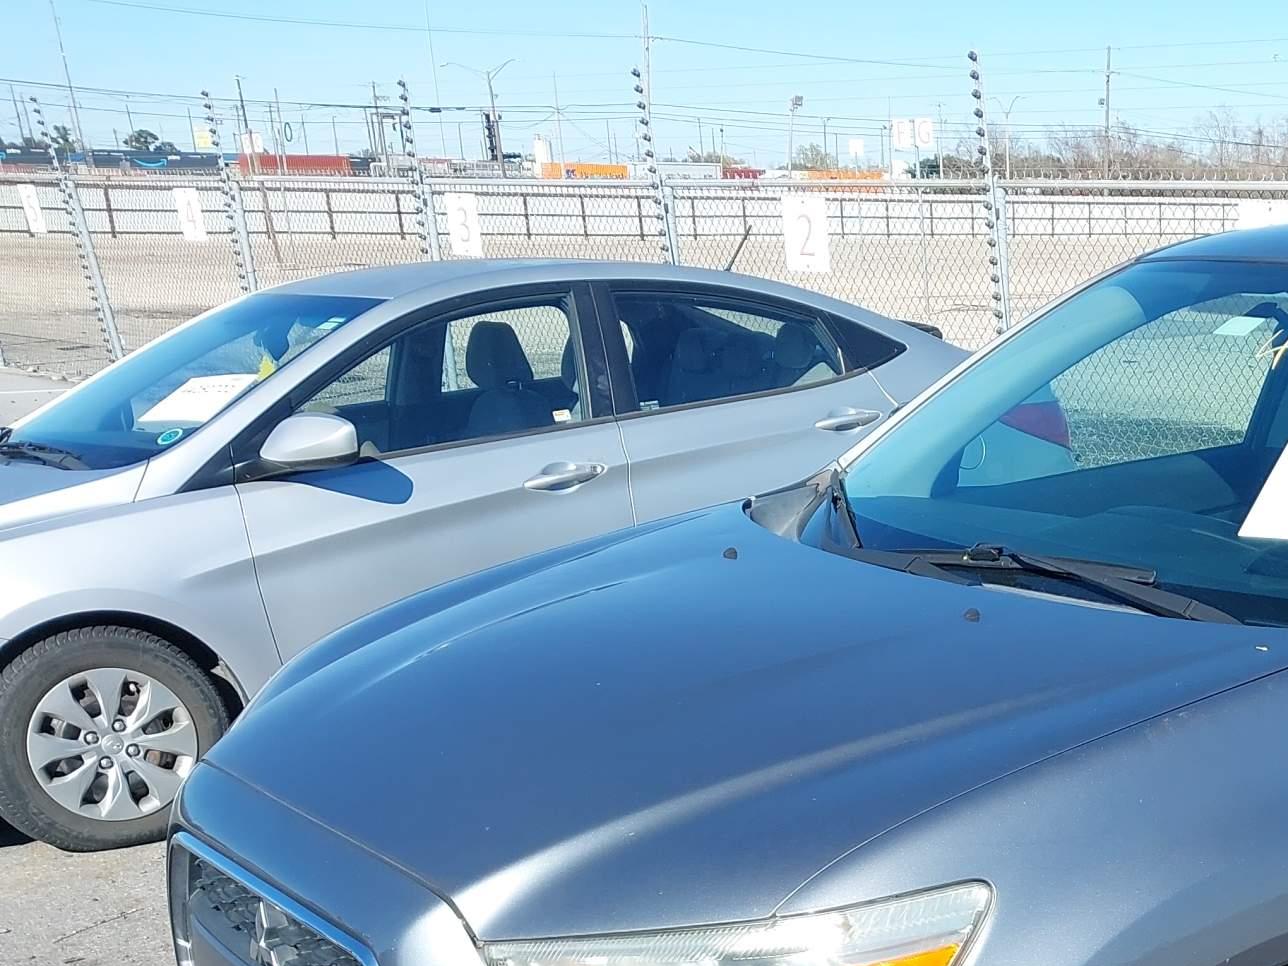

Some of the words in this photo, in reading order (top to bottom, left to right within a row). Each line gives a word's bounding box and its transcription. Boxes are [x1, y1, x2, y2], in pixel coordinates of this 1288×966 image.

[917, 120, 930, 144] G
[186, 199, 197, 230] 4
[457, 207, 471, 243] 3
[797, 213, 816, 257] 2
